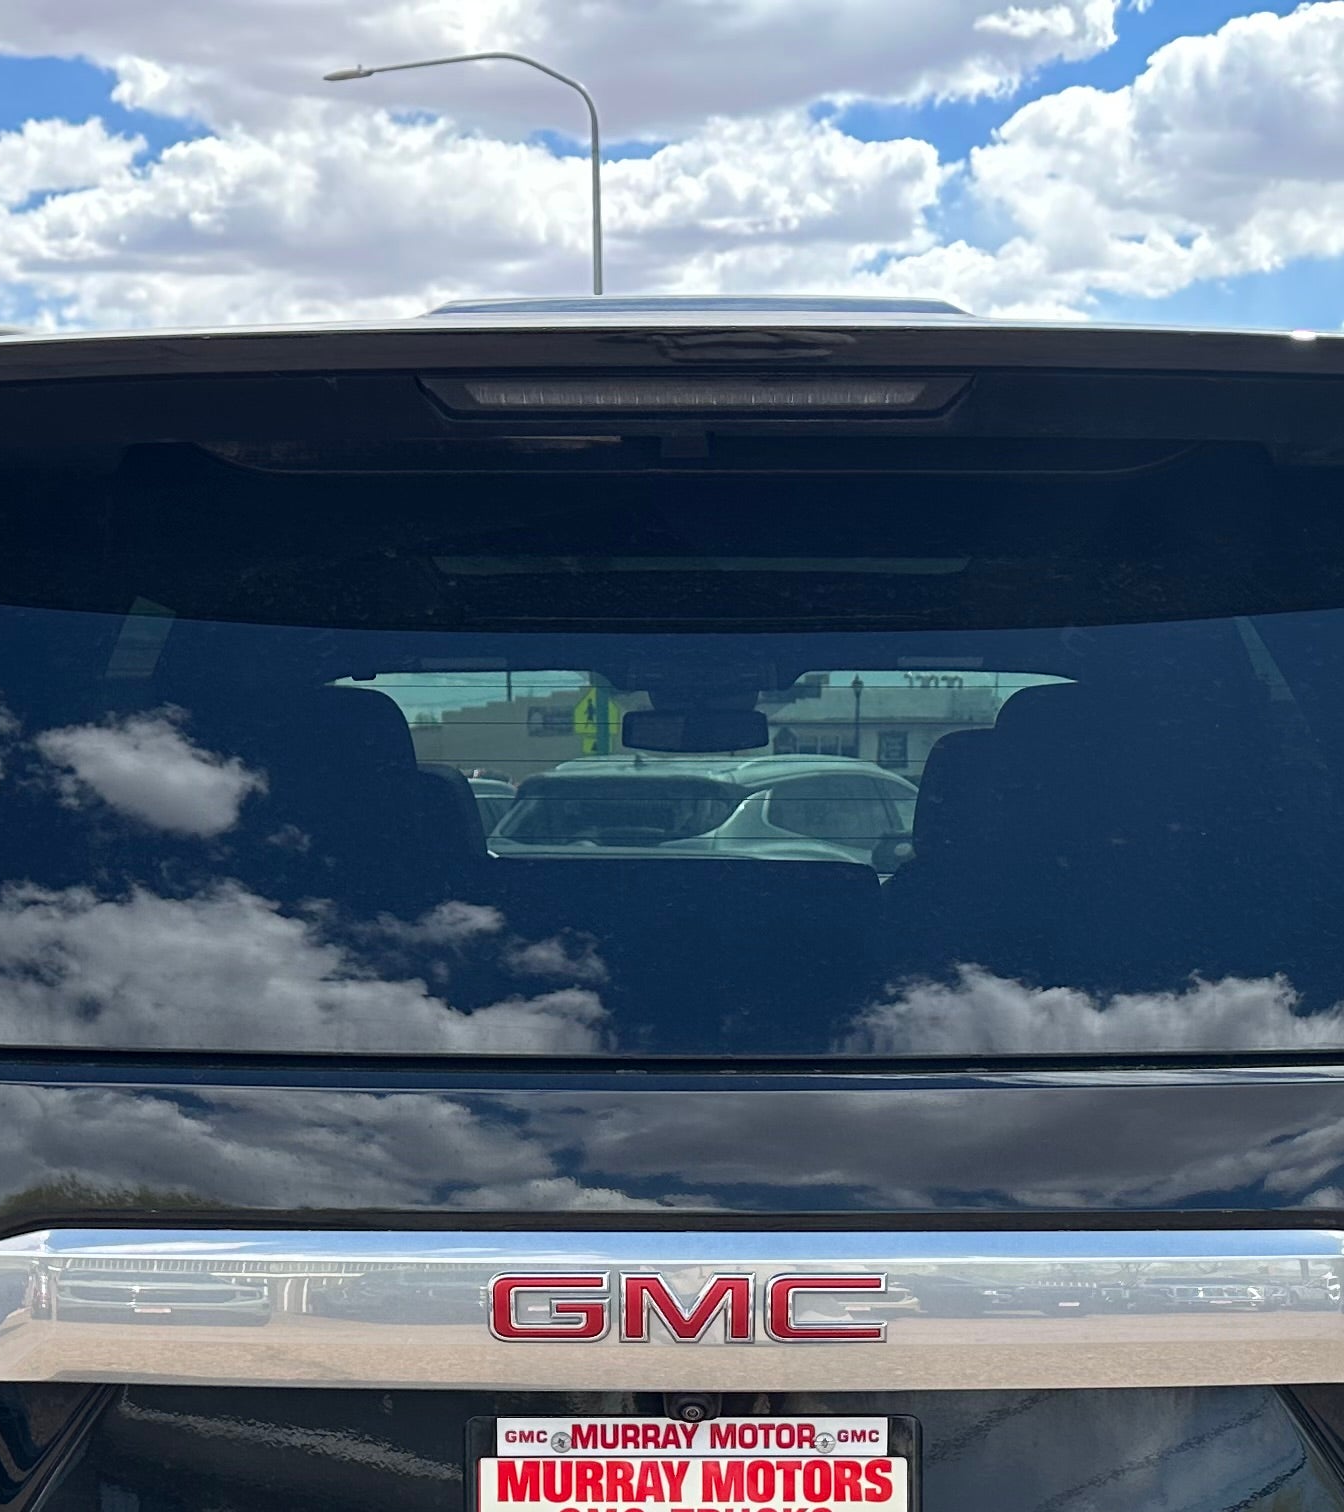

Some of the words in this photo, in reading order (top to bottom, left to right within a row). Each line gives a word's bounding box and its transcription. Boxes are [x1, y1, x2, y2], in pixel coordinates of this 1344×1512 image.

[488, 1270, 888, 1344] GMC
[504, 1429, 548, 1444] GMC
[570, 1423, 700, 1450] MURRAY
[709, 1423, 817, 1450] MOTOR
[837, 1429, 880, 1443] GMC
[496, 1459, 687, 1503] MURRAY
[701, 1458, 894, 1503] MOTORS
